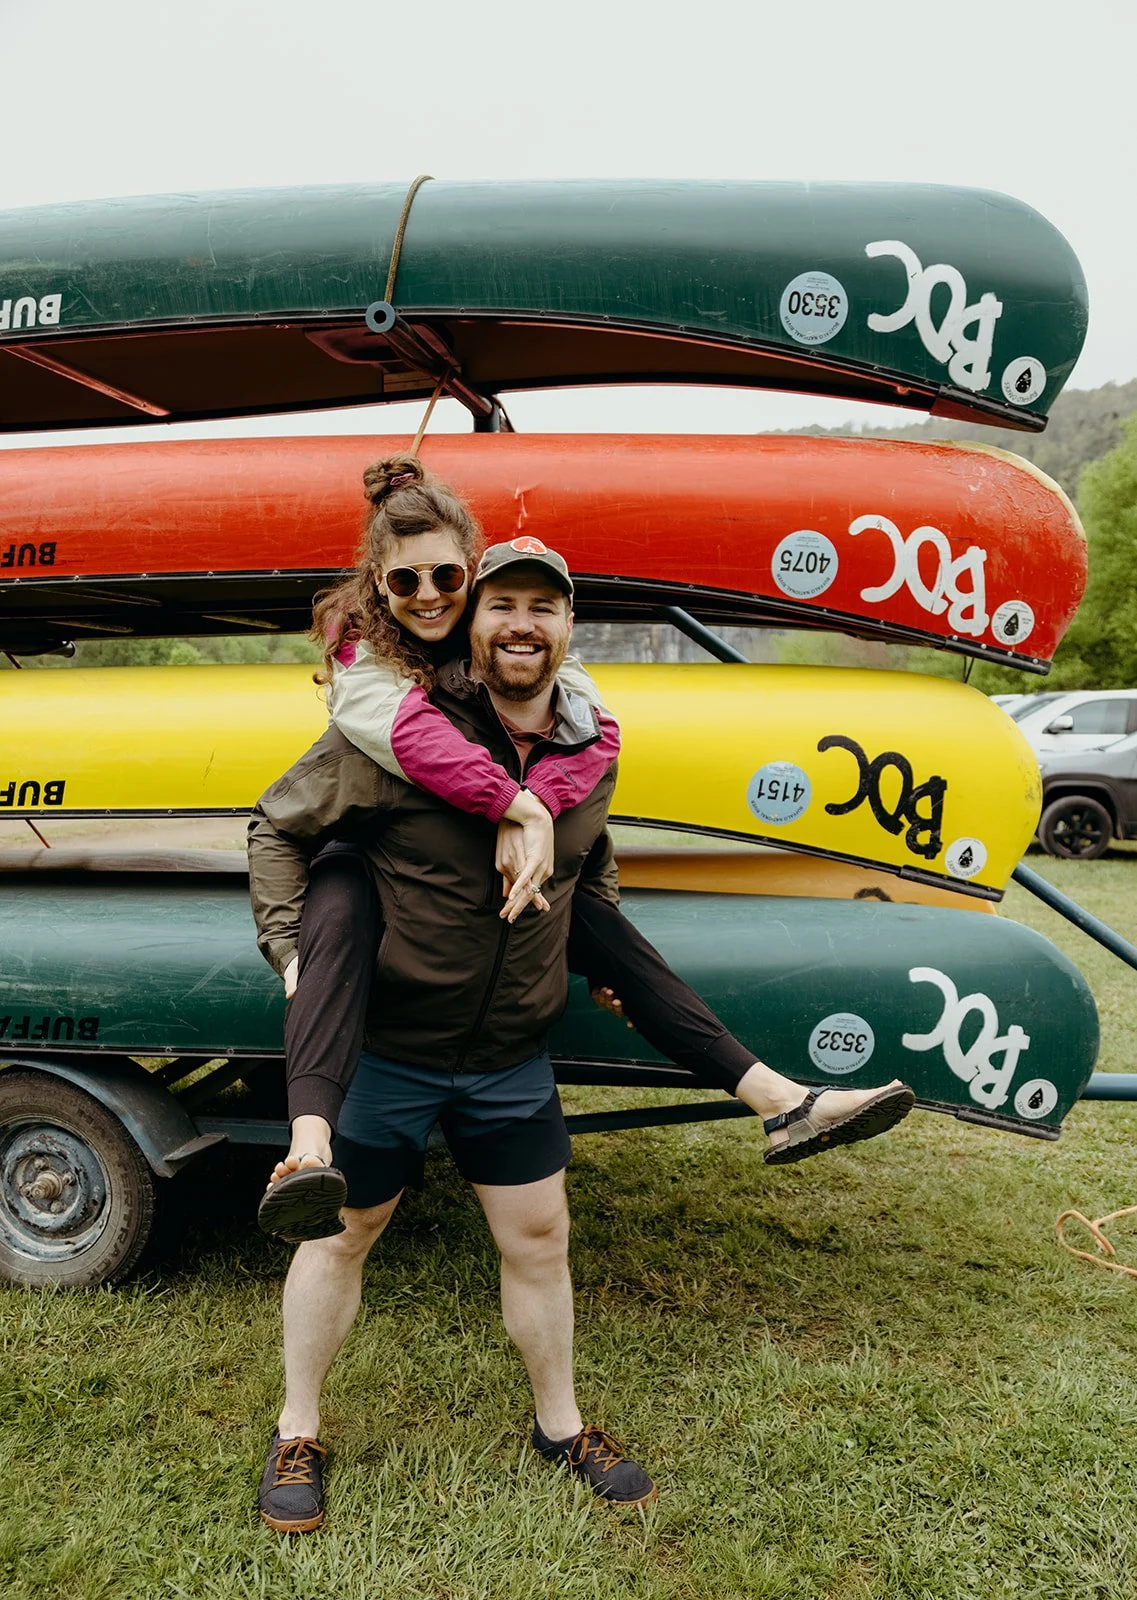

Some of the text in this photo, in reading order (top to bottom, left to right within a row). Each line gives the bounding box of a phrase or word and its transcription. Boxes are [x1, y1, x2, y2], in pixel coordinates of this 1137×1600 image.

[788, 291, 840, 319] 3530
[865, 240, 1003, 393] BOC
[780, 550, 831, 574] 4075
[848, 514, 991, 637] BOC
[757, 779, 805, 803] 4151
[817, 735, 948, 861] BOC
[817, 1030, 868, 1054] 3532
[902, 966, 1030, 1111] BOC
